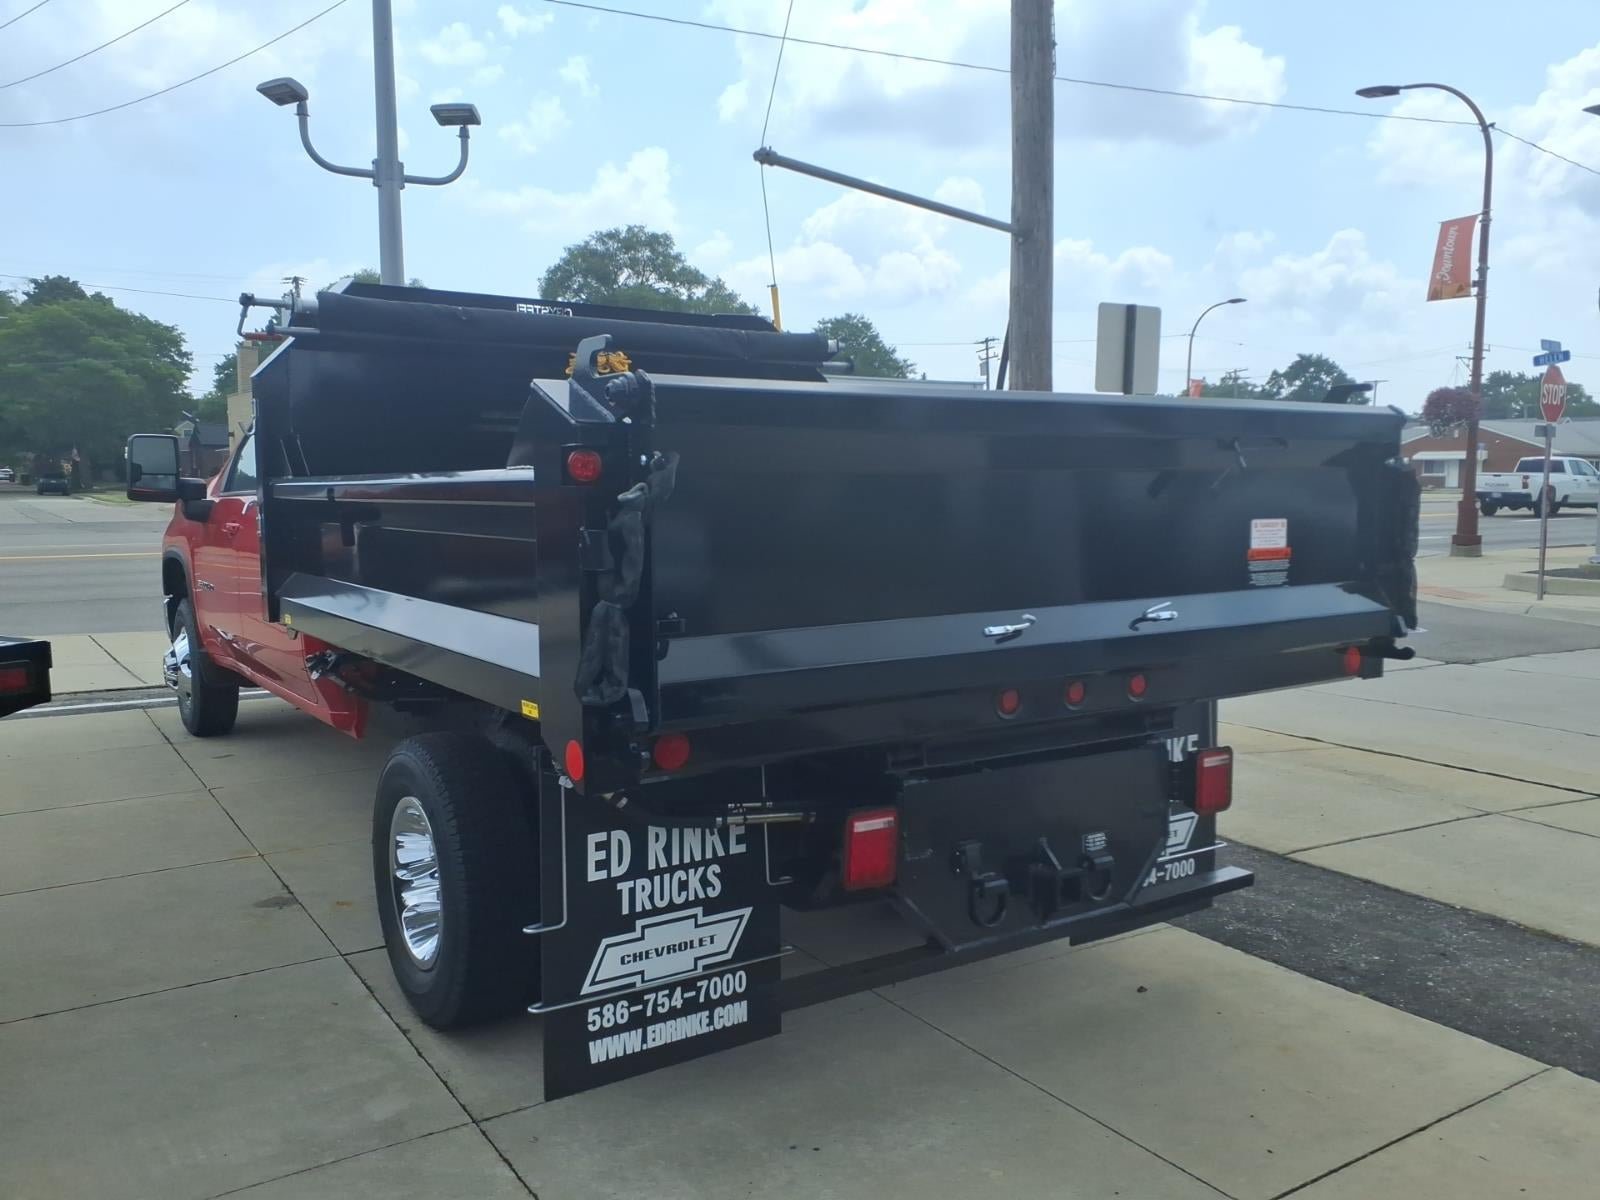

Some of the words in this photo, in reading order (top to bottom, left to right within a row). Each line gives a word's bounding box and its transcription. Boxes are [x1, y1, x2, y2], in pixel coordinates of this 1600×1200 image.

[1542, 383, 1565, 405] STOP
[587, 829, 631, 882] ED
[648, 825, 747, 871] RINKE
[617, 864, 722, 915] TRUCKS
[620, 934, 717, 966] CHEVROLET
[587, 970, 747, 1032] 586-754-7000
[588, 1000, 748, 1064] WWW.EDRINKE.COM
